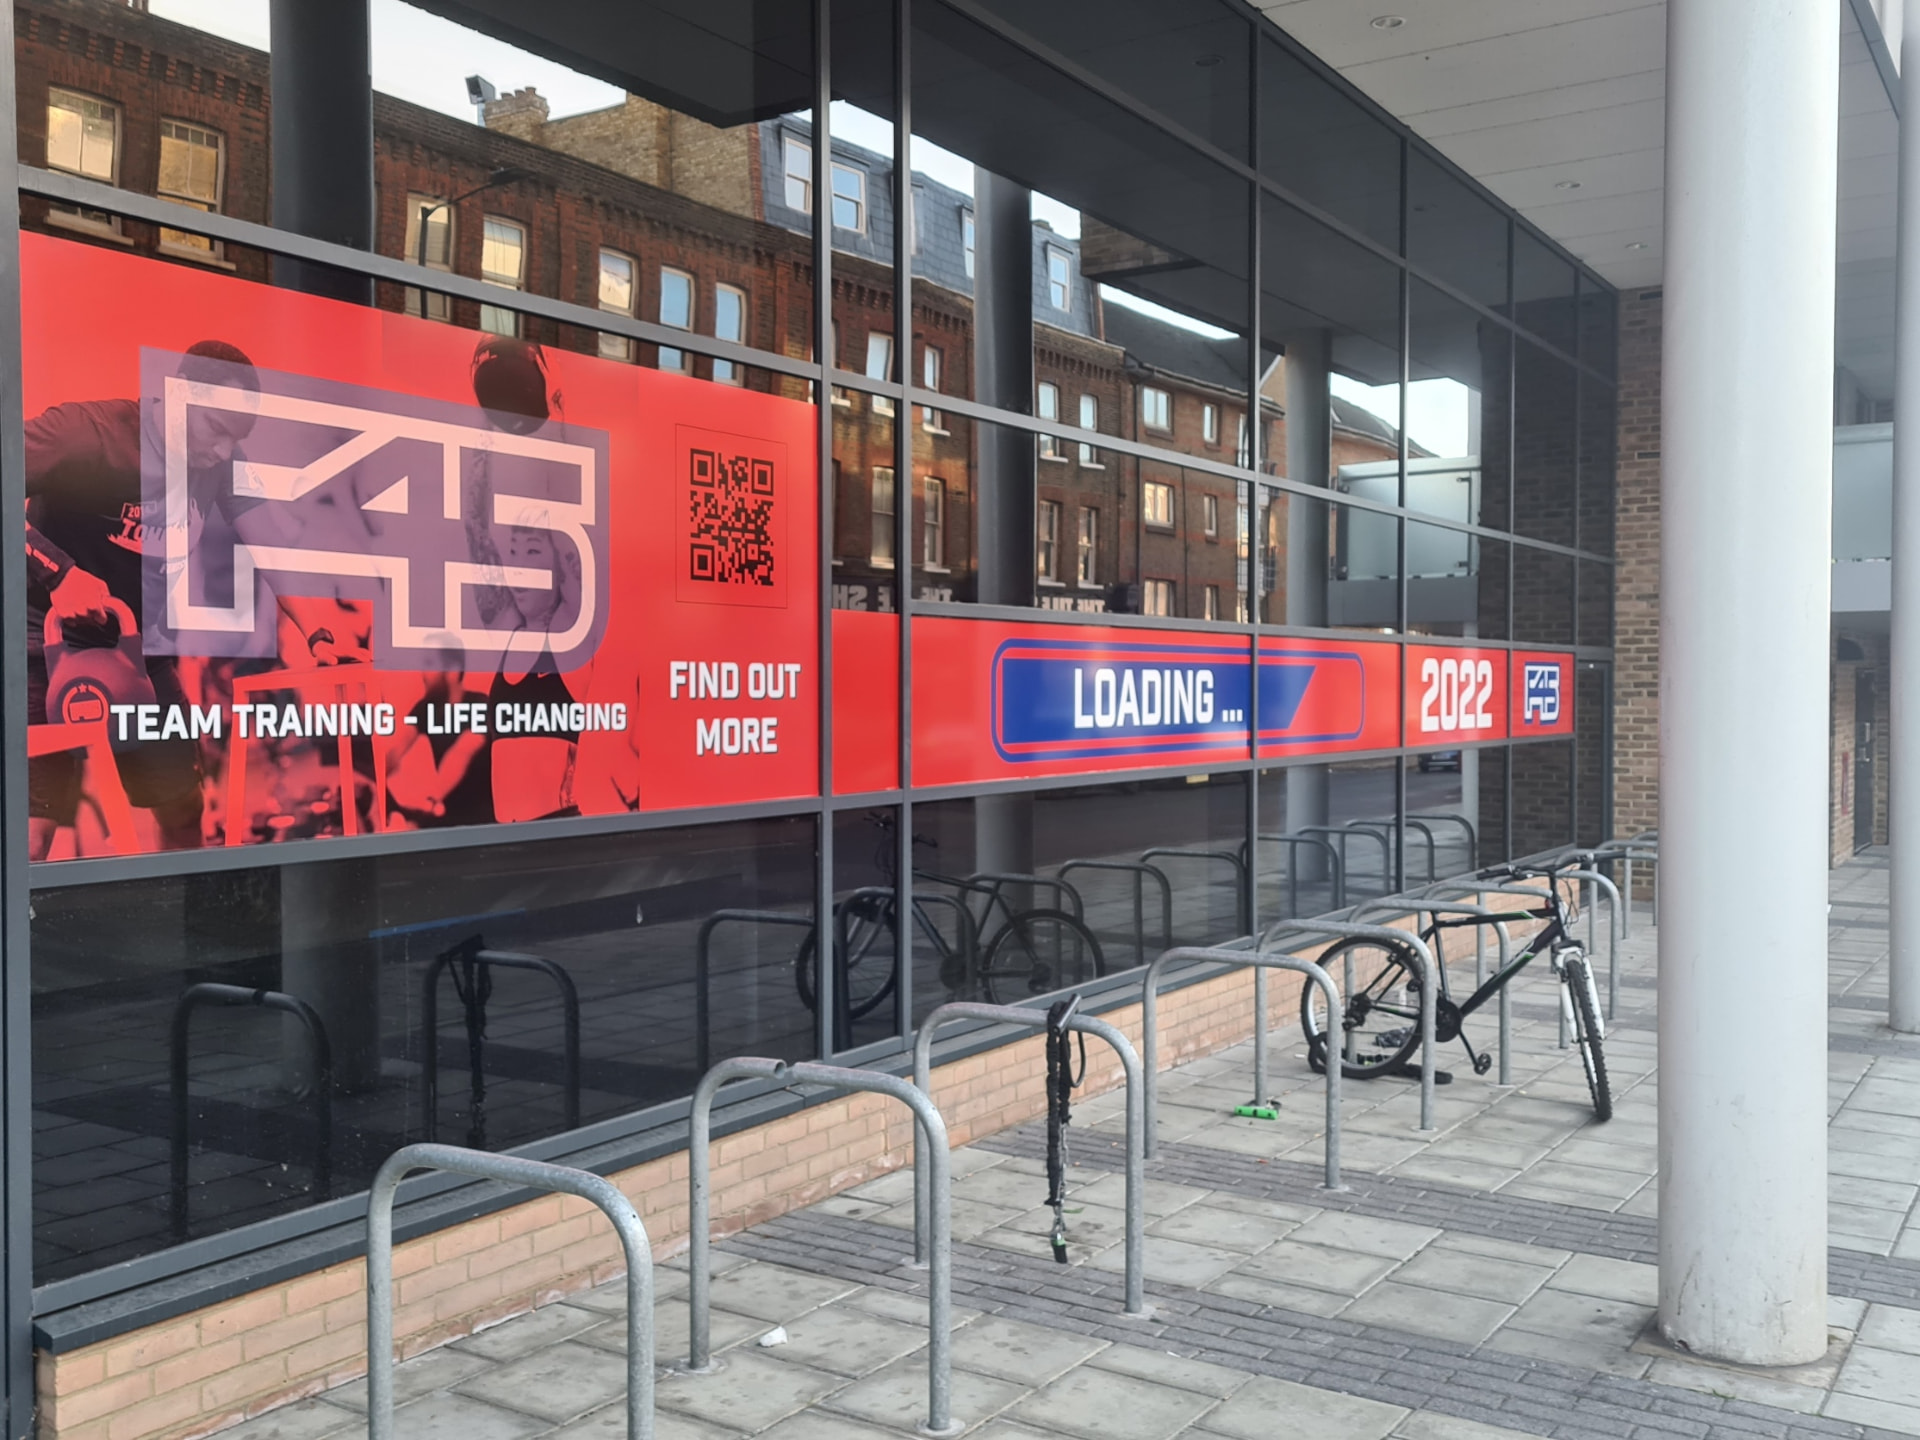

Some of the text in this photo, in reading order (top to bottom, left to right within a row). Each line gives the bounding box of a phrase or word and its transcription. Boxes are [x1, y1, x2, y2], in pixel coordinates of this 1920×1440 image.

[164, 376, 596, 652] F45
[670, 661, 801, 699] FIND OUT
[1074, 668, 1214, 729] LOADING
[1421, 658, 1493, 732] 2022
[1524, 663, 1560, 724] F45
[110, 704, 221, 741] TEAM
[232, 703, 394, 738] TRAINING
[427, 703, 488, 734] LIFE
[495, 703, 627, 732] CHANGING
[696, 717, 778, 756] MORE
